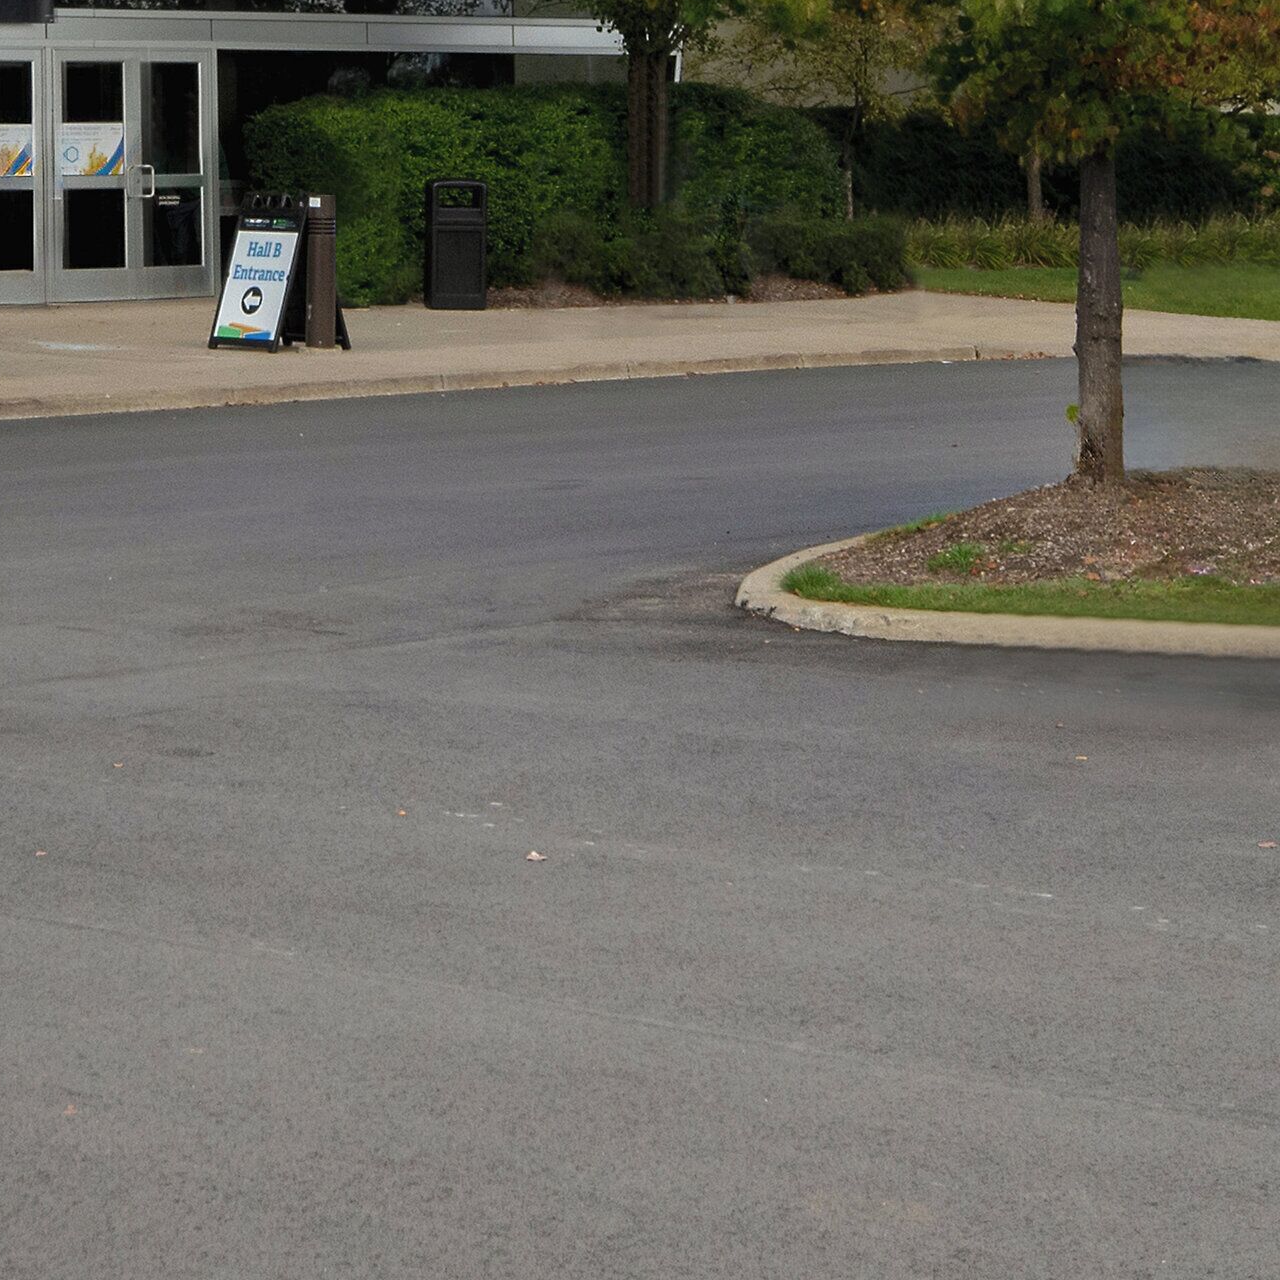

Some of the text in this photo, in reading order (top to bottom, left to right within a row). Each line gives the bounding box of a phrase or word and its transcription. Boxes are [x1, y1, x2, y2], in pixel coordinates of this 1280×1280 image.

[247, 241, 282, 258] Hall B
[233, 264, 285, 281] Entrance
